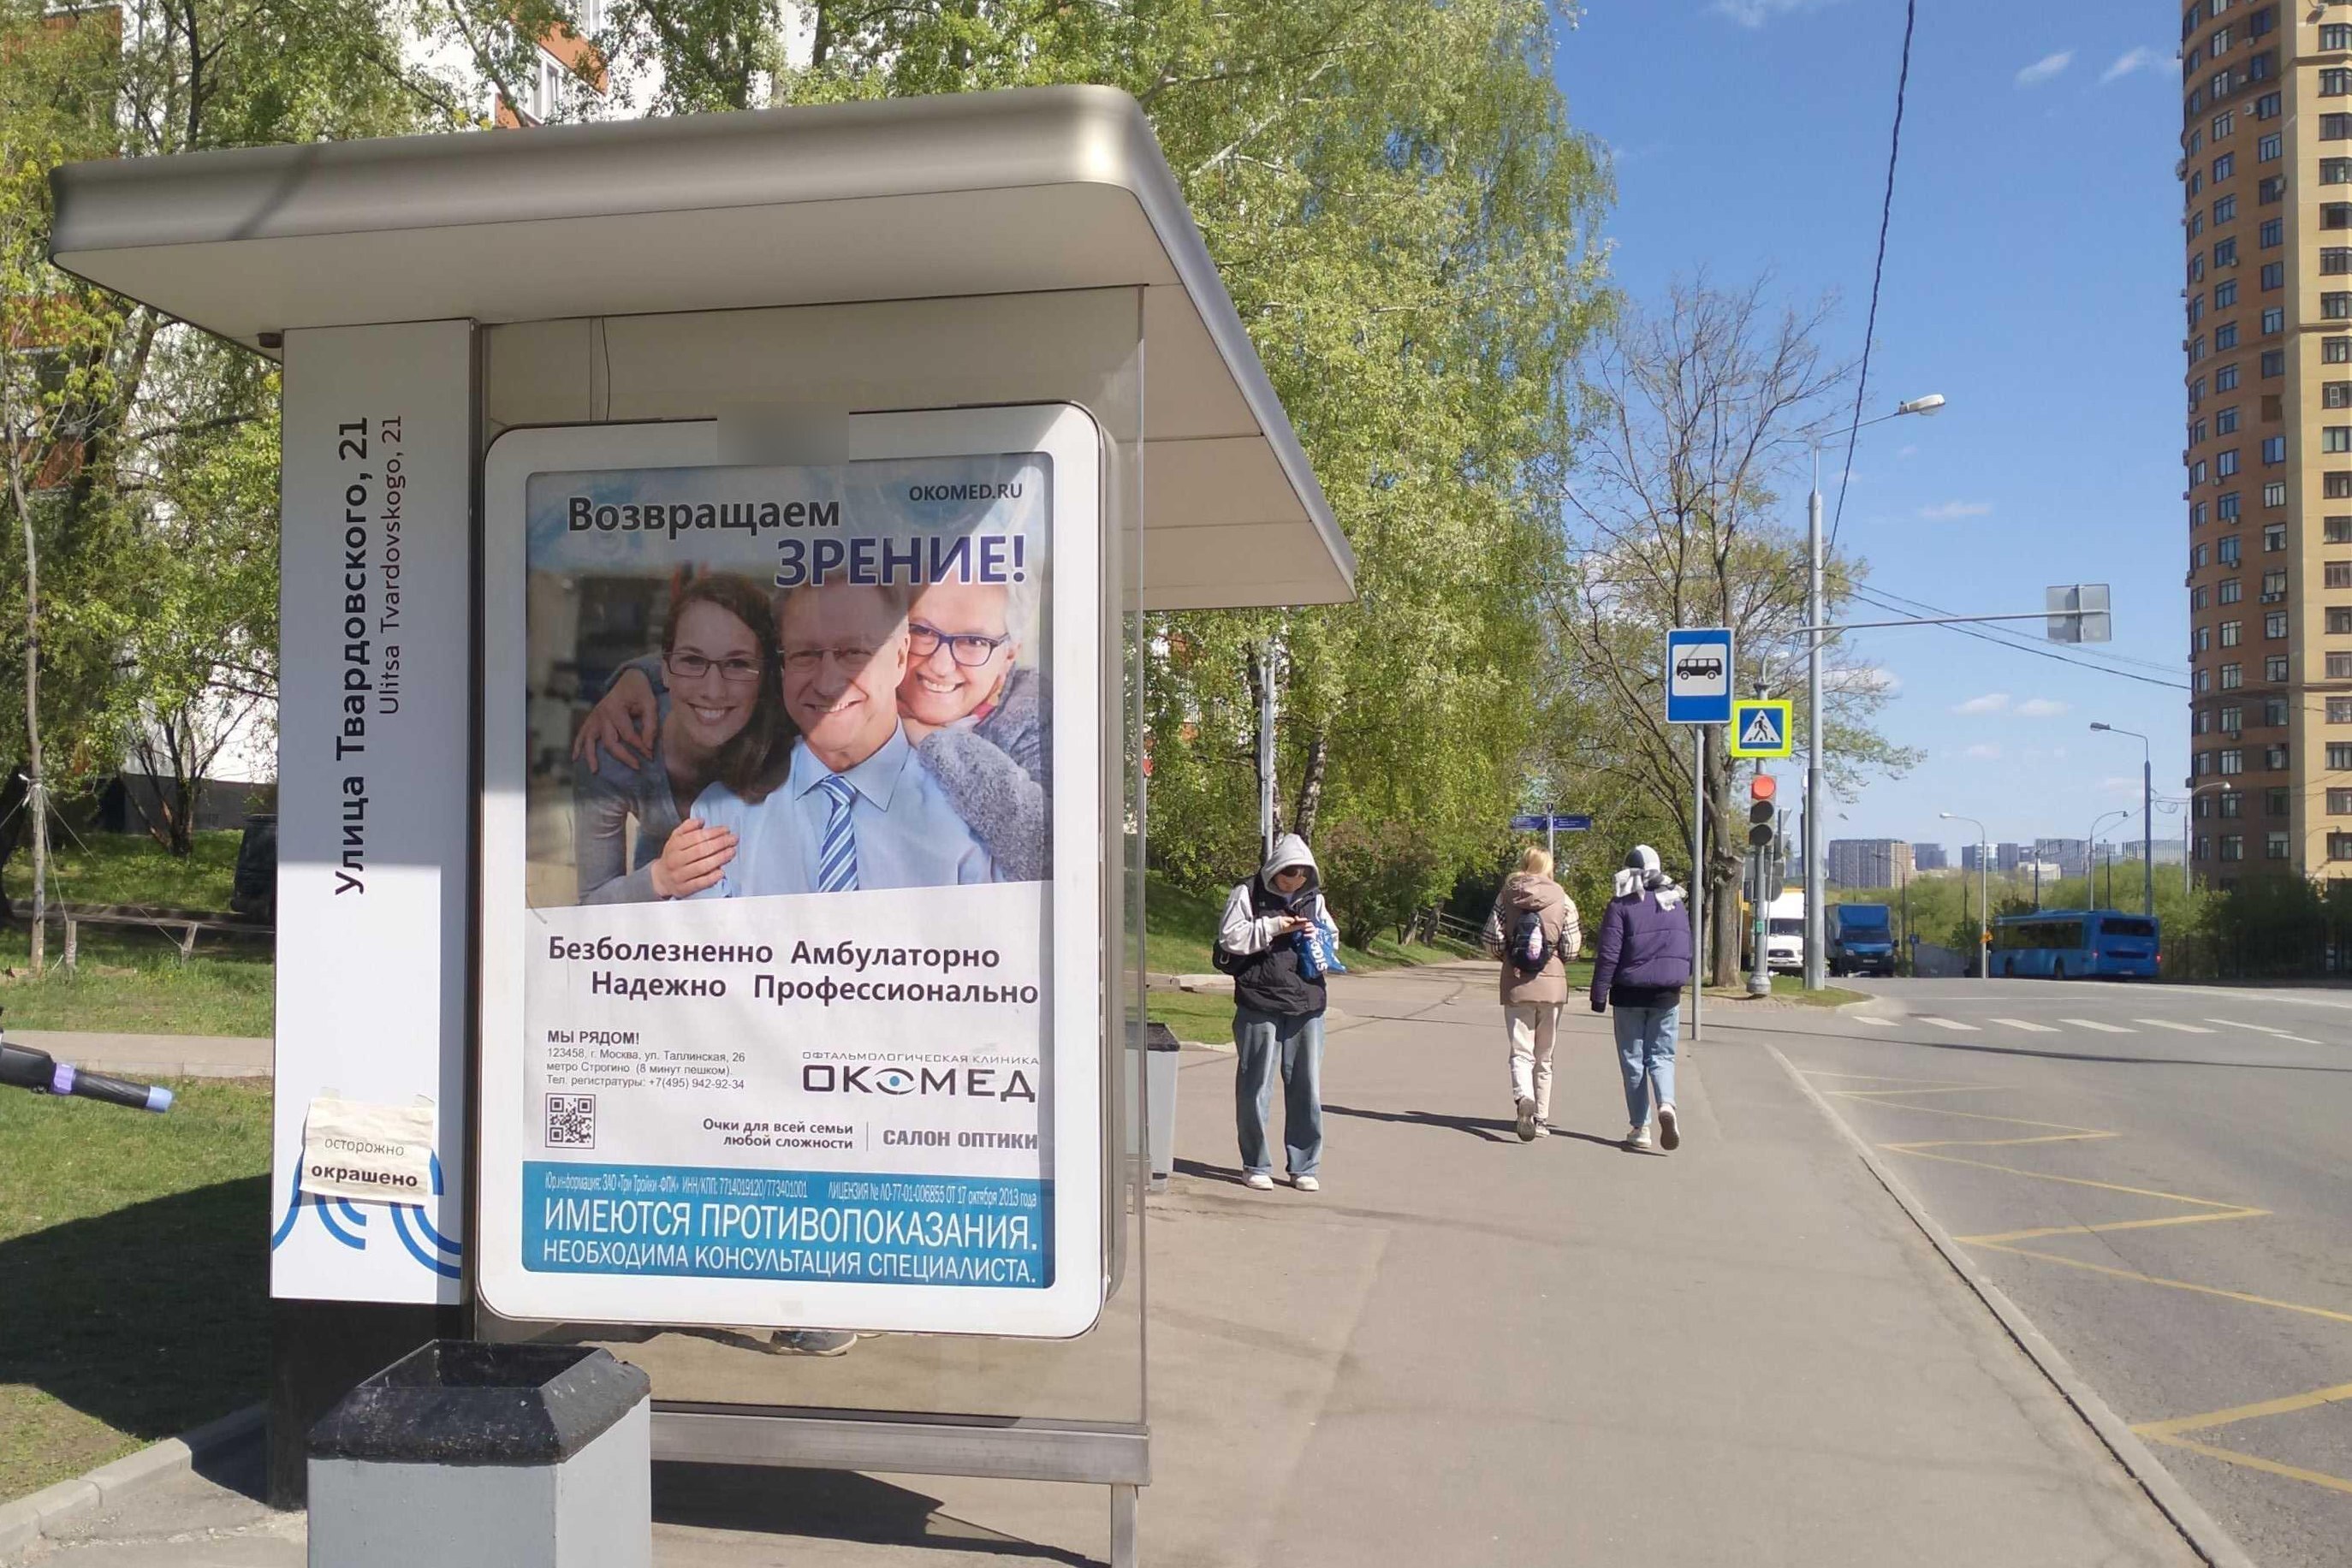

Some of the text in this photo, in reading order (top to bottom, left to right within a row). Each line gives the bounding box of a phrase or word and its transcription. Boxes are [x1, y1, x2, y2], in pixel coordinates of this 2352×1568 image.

[908, 483, 1024, 502] OKOMED.RU
[567, 496, 840, 539] Возвращаем
[378, 414, 407, 715] Ulitsa Tvardovskogo, 21
[775, 534, 1026, 586] ЗРЕНИЕ!
[335, 416, 373, 895] Улица Твардовского, 21
[549, 935, 1001, 974] Безболезненно Амбулаторно
[591, 971, 1039, 1007] Надежно Профессионально
[547, 1030, 640, 1047] МЫ РЯДОМ!
[599, 1048, 642, 1060] Москва,
[662, 1049, 729, 1064] Таллинская,
[732, 1051, 745, 1062] 26
[802, 1051, 1040, 1066] ОФТАЛЬМОЛОГИЧЕСКАЯ КЛИНИКА
[546, 1063, 579, 1073] метро
[581, 1061, 631, 1074] Строгино
[650, 1065, 681, 1076] минут
[571, 1076, 646, 1089] регистратуры:
[692, 1078, 745, 1090] 942-92-34
[703, 1118, 853, 1135] Очки для всей семьи
[324, 1137, 405, 1156] осторожно
[723, 1133, 853, 1149] любой сложности
[882, 1129, 1038, 1150] САЛОН ОПТИКИ
[311, 1165, 419, 1188] окрашено
[958, 1185, 967, 1204] 17
[999, 1187, 1019, 1207] 2013
[544, 1197, 1038, 1251] ИМЕЮТСЯ ПРОТИВОПОКАЗАНИЯ.
[543, 1239, 1036, 1284] НЕОБХОДИМА КОНСУЛЬТАЦИЯ СПЕЦИАЛИСТА.
